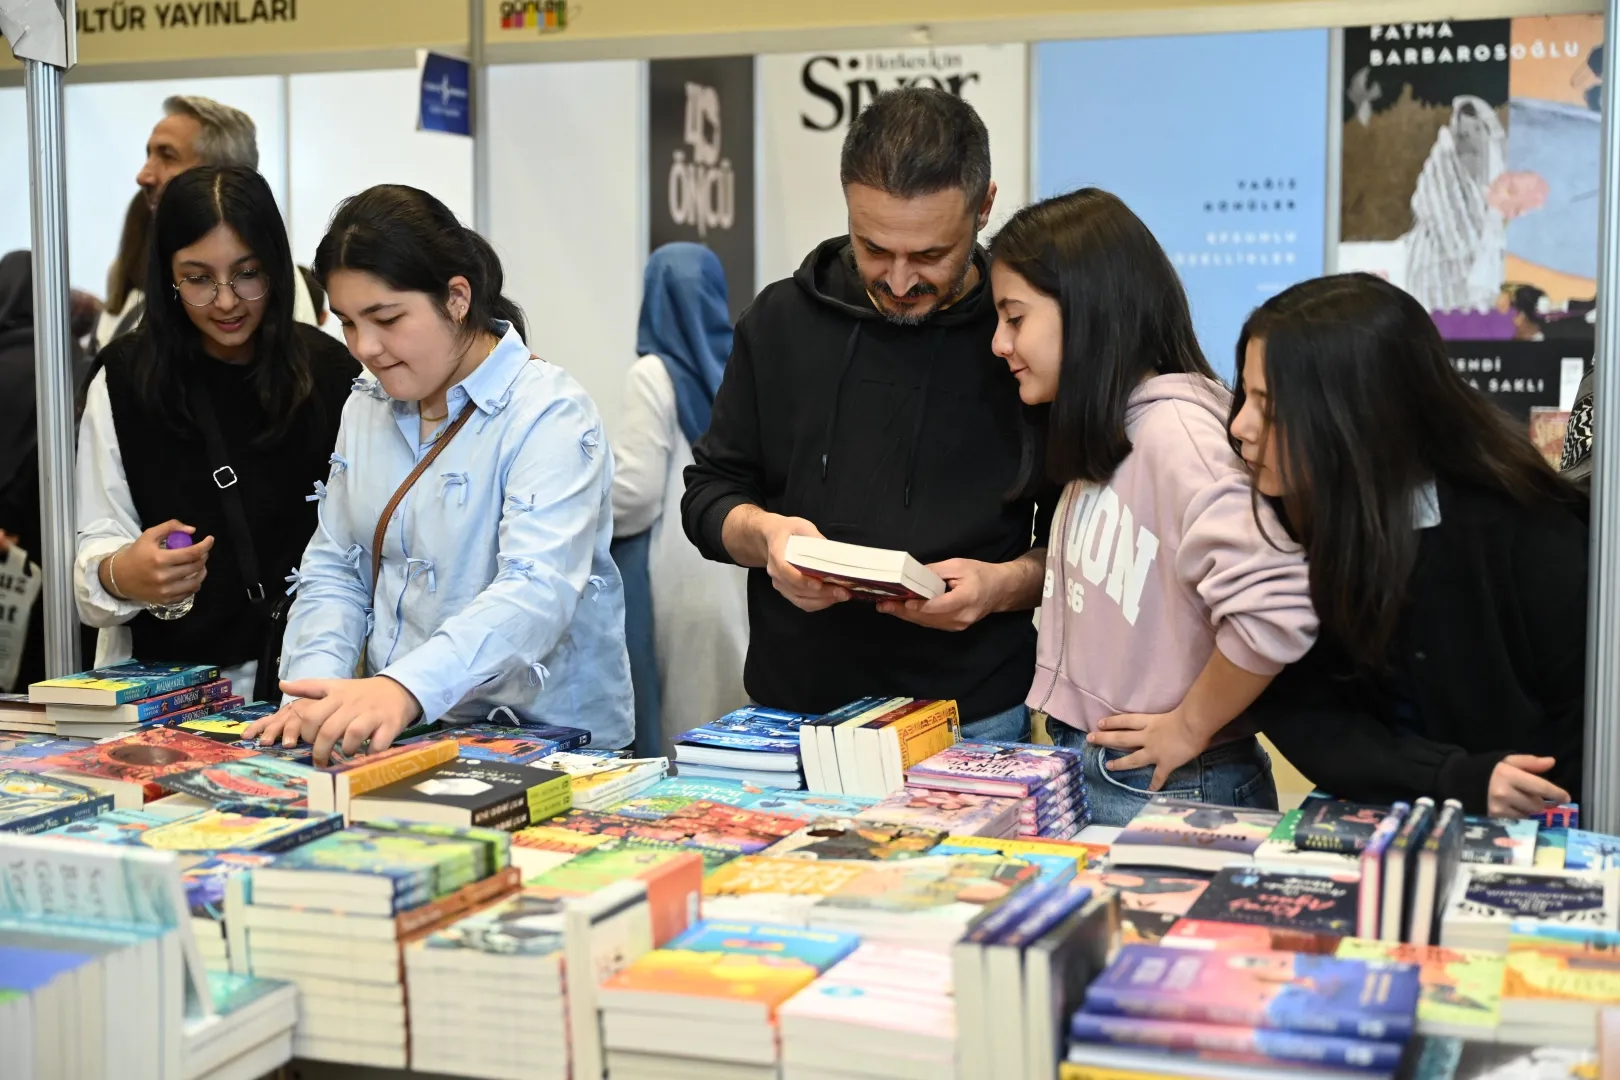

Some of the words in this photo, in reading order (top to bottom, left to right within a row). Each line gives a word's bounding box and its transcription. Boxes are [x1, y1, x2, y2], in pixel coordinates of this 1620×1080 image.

[154, 0, 298, 29] YAYINLARI
[1370, 22, 1453, 41] FATMA
[1369, 39, 1579, 67] BARBAROSOĞLU
[1173, 251, 1297, 268] ÜZELLİKLER
[1488, 377, 1544, 393] SAKLI
[123, 688, 141, 696] THOMAS
[123, 693, 141, 701] TAYLOR
[143, 704, 160, 712] THOMAS
[143, 709, 160, 717] TAYLOR
